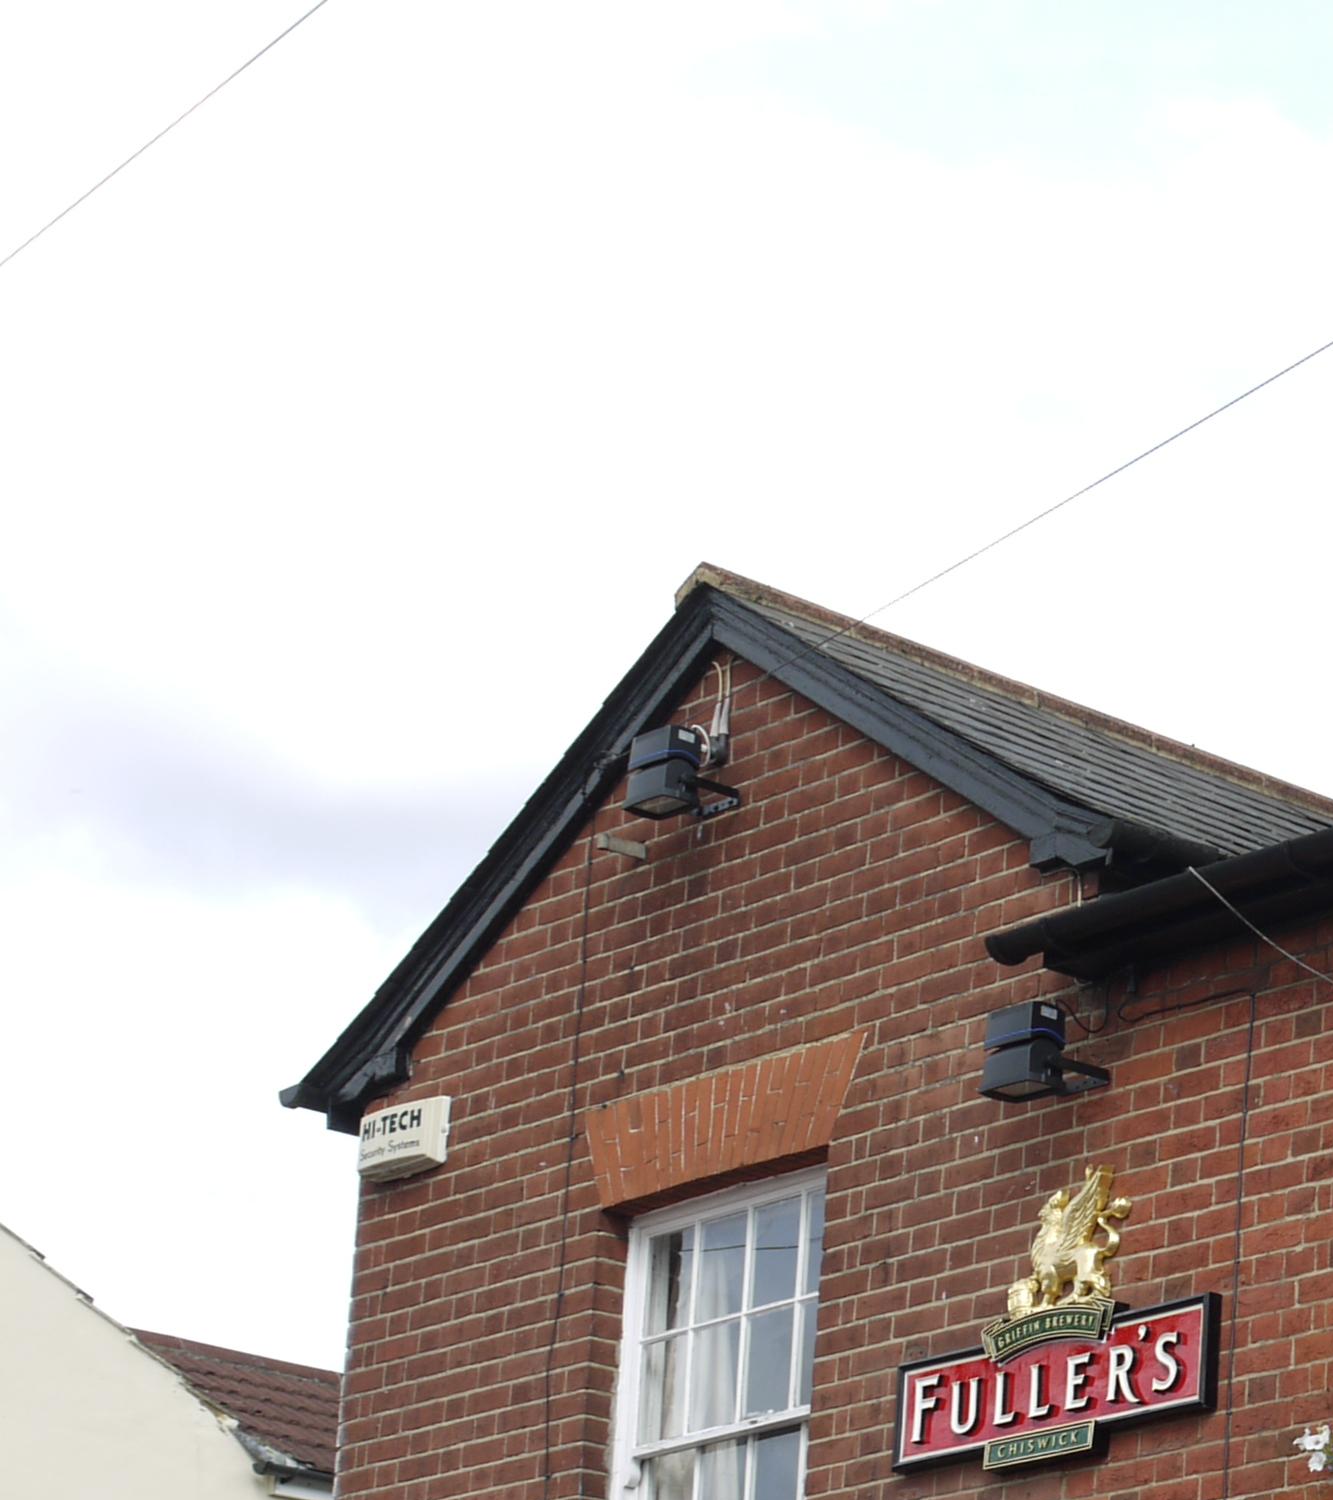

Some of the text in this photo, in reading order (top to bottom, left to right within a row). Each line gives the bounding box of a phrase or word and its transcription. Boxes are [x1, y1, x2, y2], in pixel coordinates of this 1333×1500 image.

[362, 1108, 422, 1142] HI-TECH
[998, 1314, 1094, 1347] GRIFFIN BREWERY
[910, 1325, 1180, 1444] FULLER'S
[997, 1430, 1081, 1458] CHISWICK
